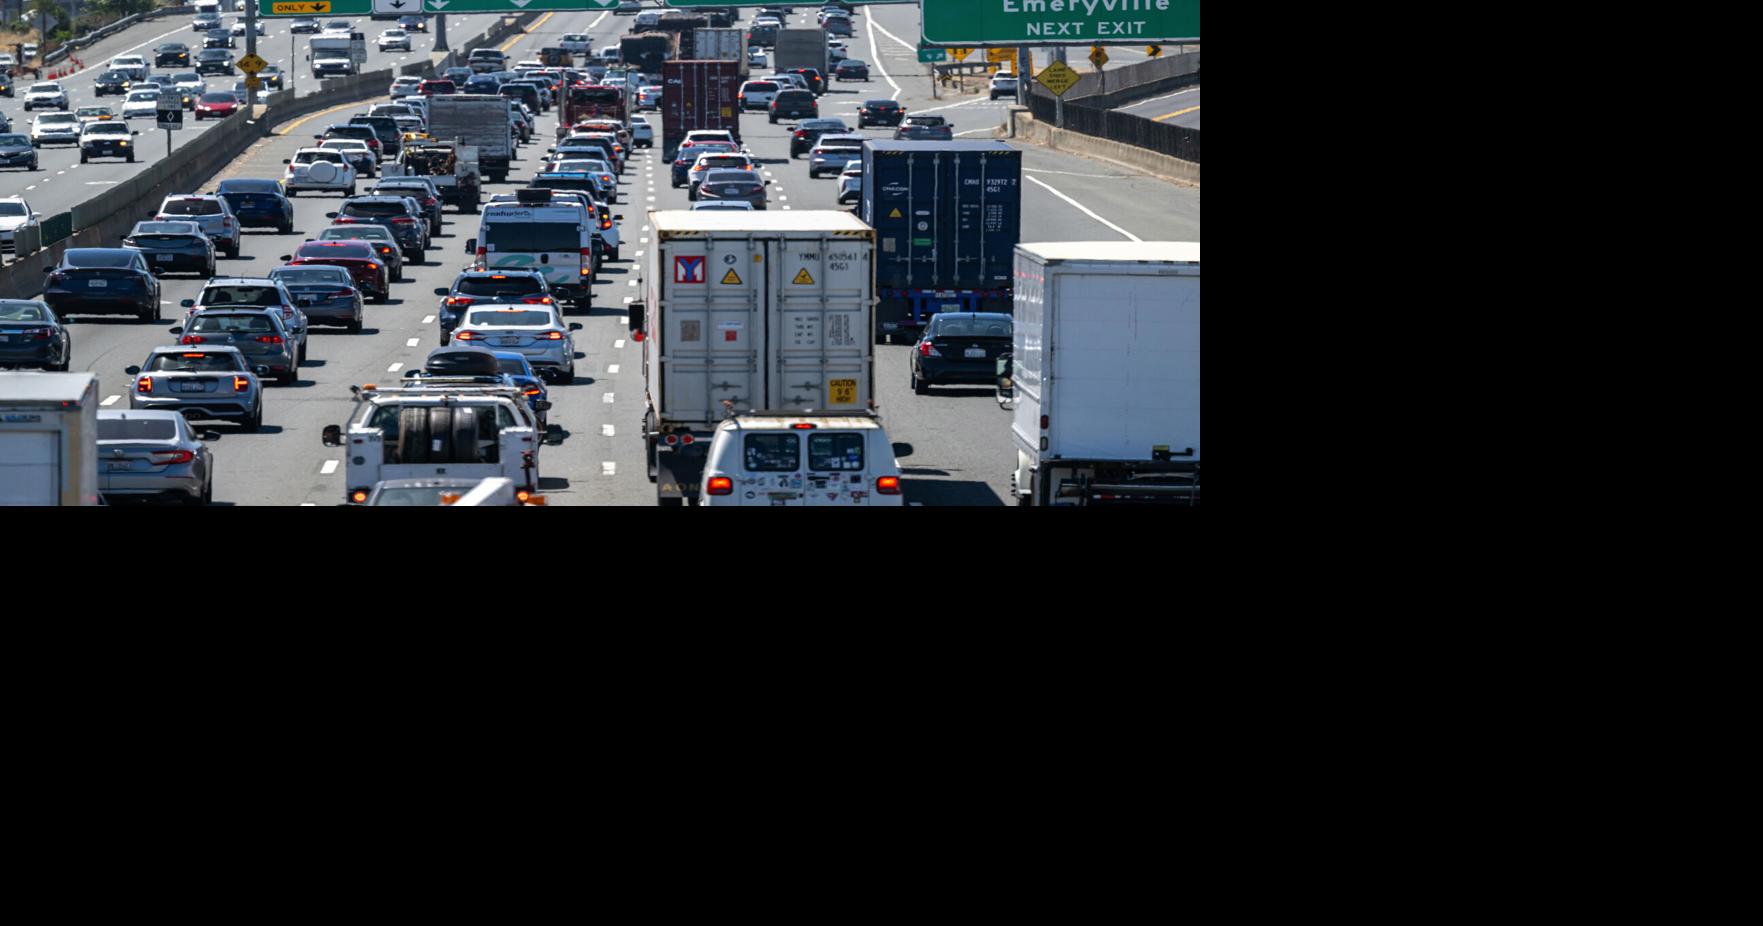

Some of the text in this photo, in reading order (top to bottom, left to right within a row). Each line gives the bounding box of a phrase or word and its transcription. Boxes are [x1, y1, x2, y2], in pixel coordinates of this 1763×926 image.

[1003, 0, 1169, 16] Emeryville
[1027, 21, 1146, 36] NEXT EXIT
[830, 262, 849, 271] 45G1
[830, 379, 857, 387] CAUTION
